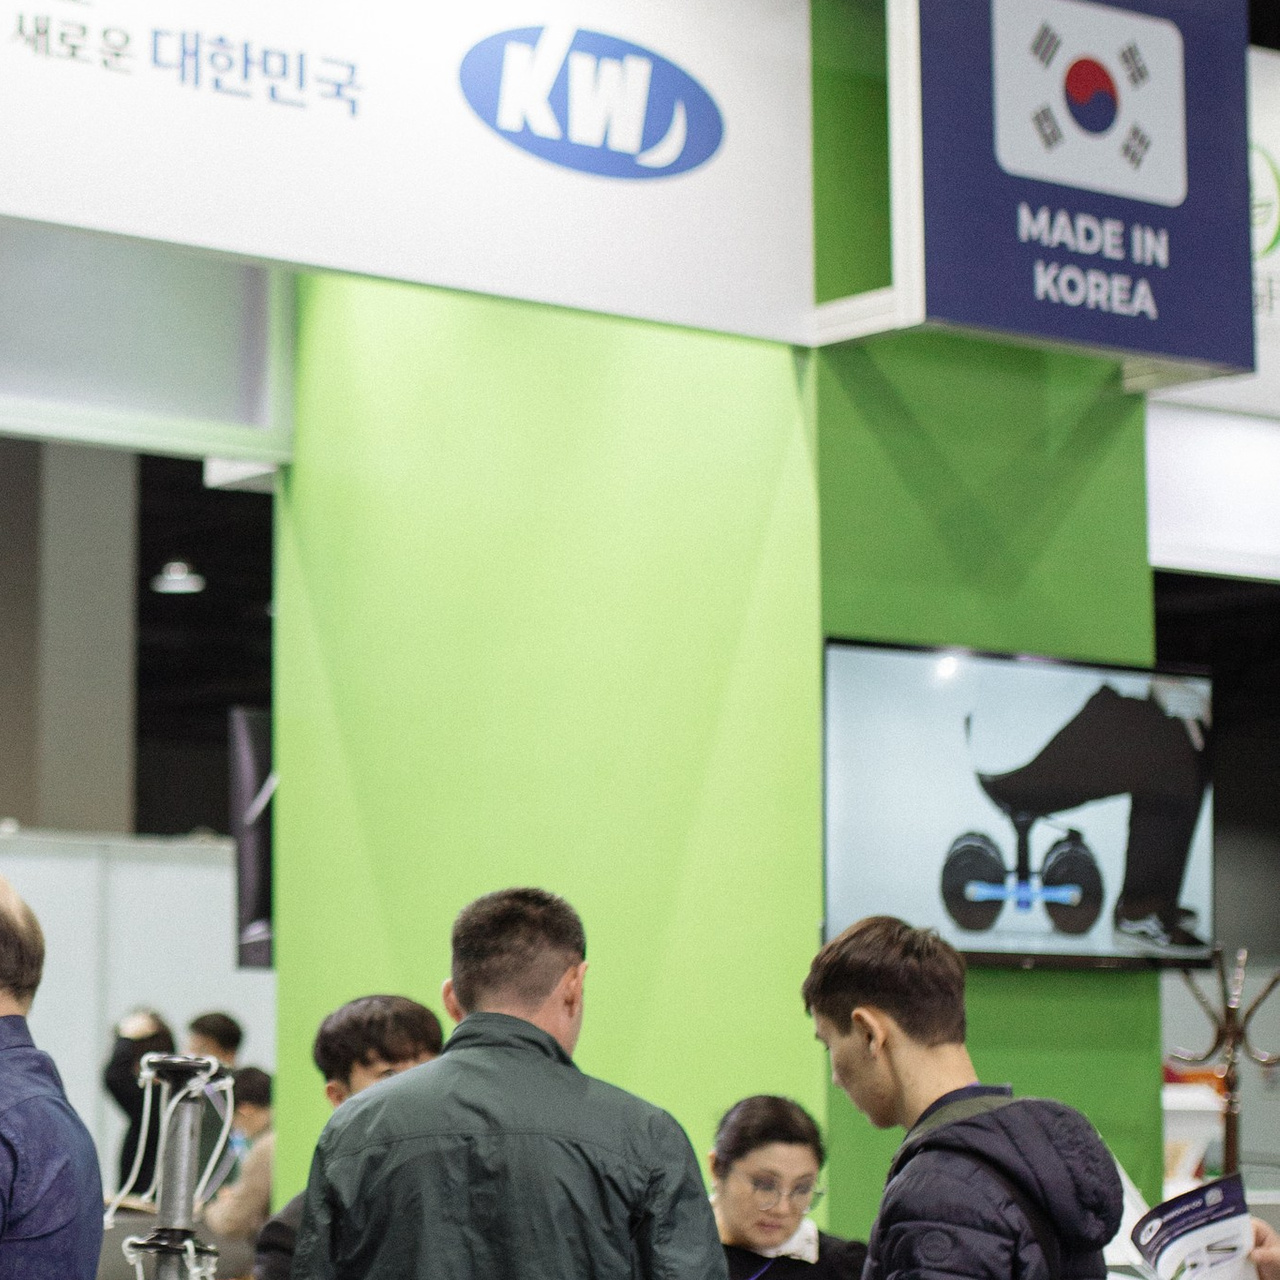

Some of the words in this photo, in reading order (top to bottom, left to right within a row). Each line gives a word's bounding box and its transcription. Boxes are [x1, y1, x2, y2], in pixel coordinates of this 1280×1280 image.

[11, 12, 136, 75] 새로운
[151, 27, 363, 117] 대한민국
[496, 23, 653, 156] KW
[1018, 201, 1126, 261] MADE
[1131, 223, 1170, 269] IN
[1034, 259, 1160, 321] KOREA
